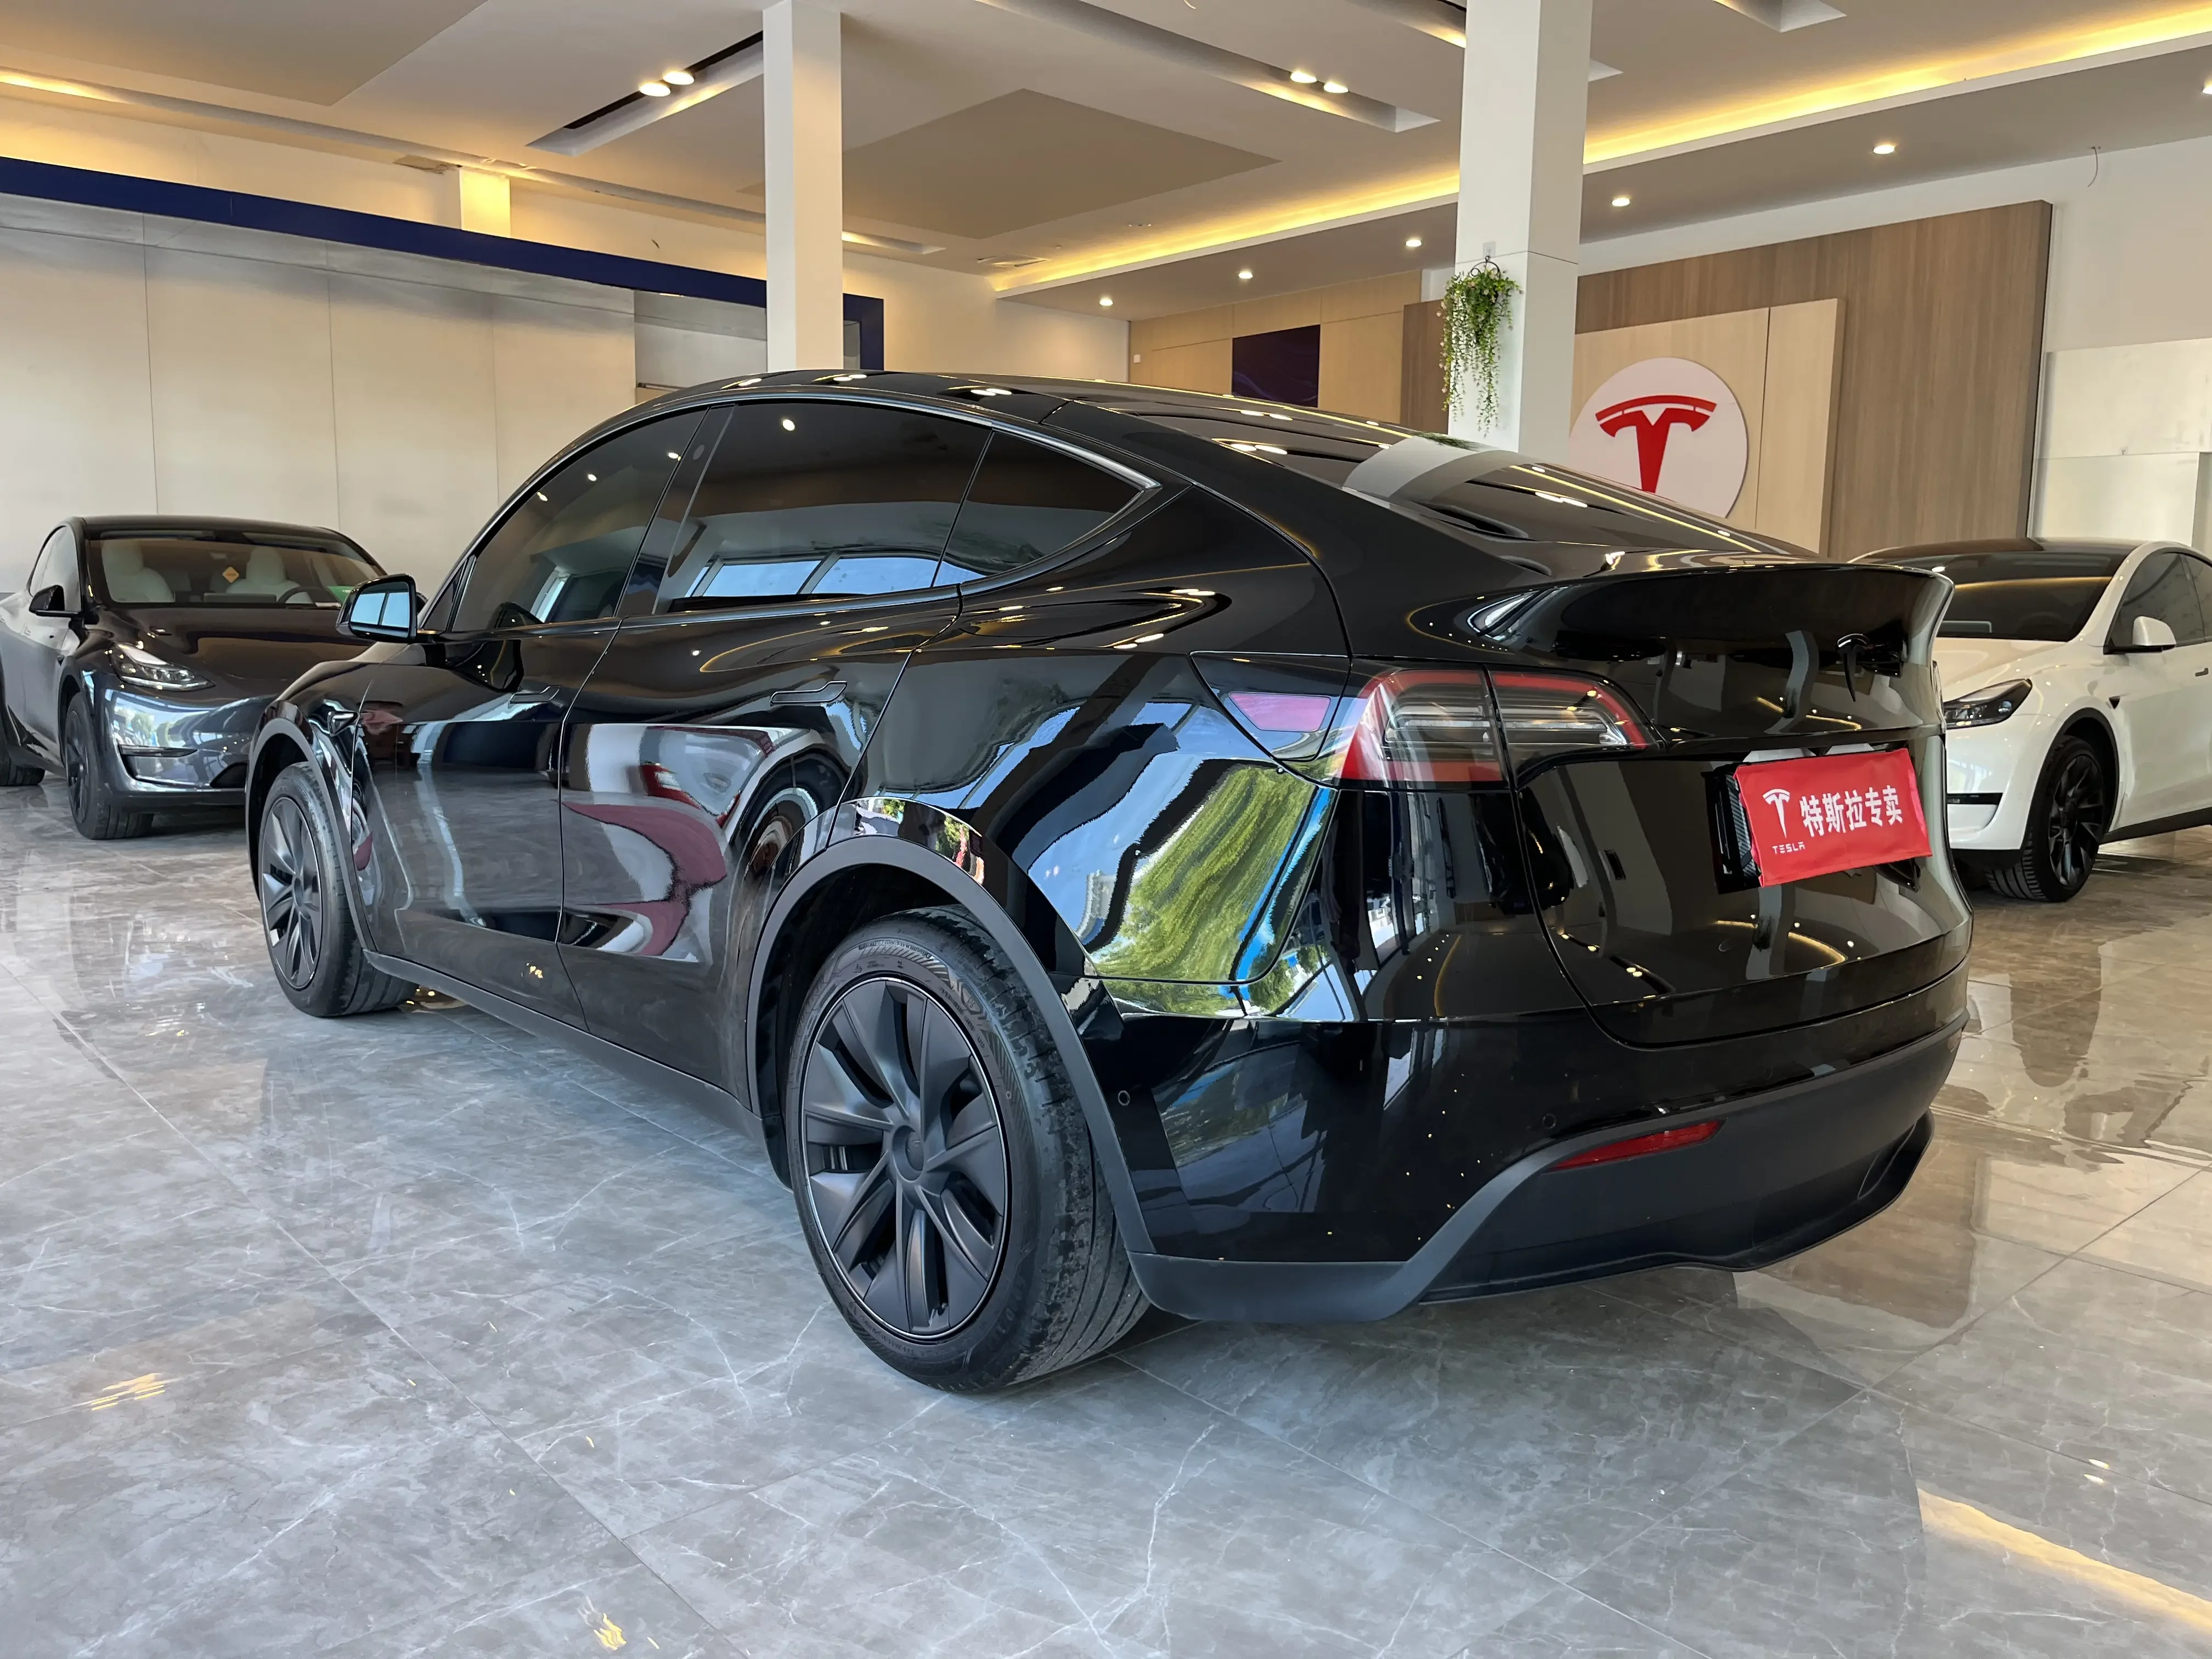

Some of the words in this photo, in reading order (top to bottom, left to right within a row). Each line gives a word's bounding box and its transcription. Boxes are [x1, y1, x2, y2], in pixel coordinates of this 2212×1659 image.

[1799, 785, 1903, 837] 特斯拉专卖
[1771, 841, 1805, 854] TESLA
